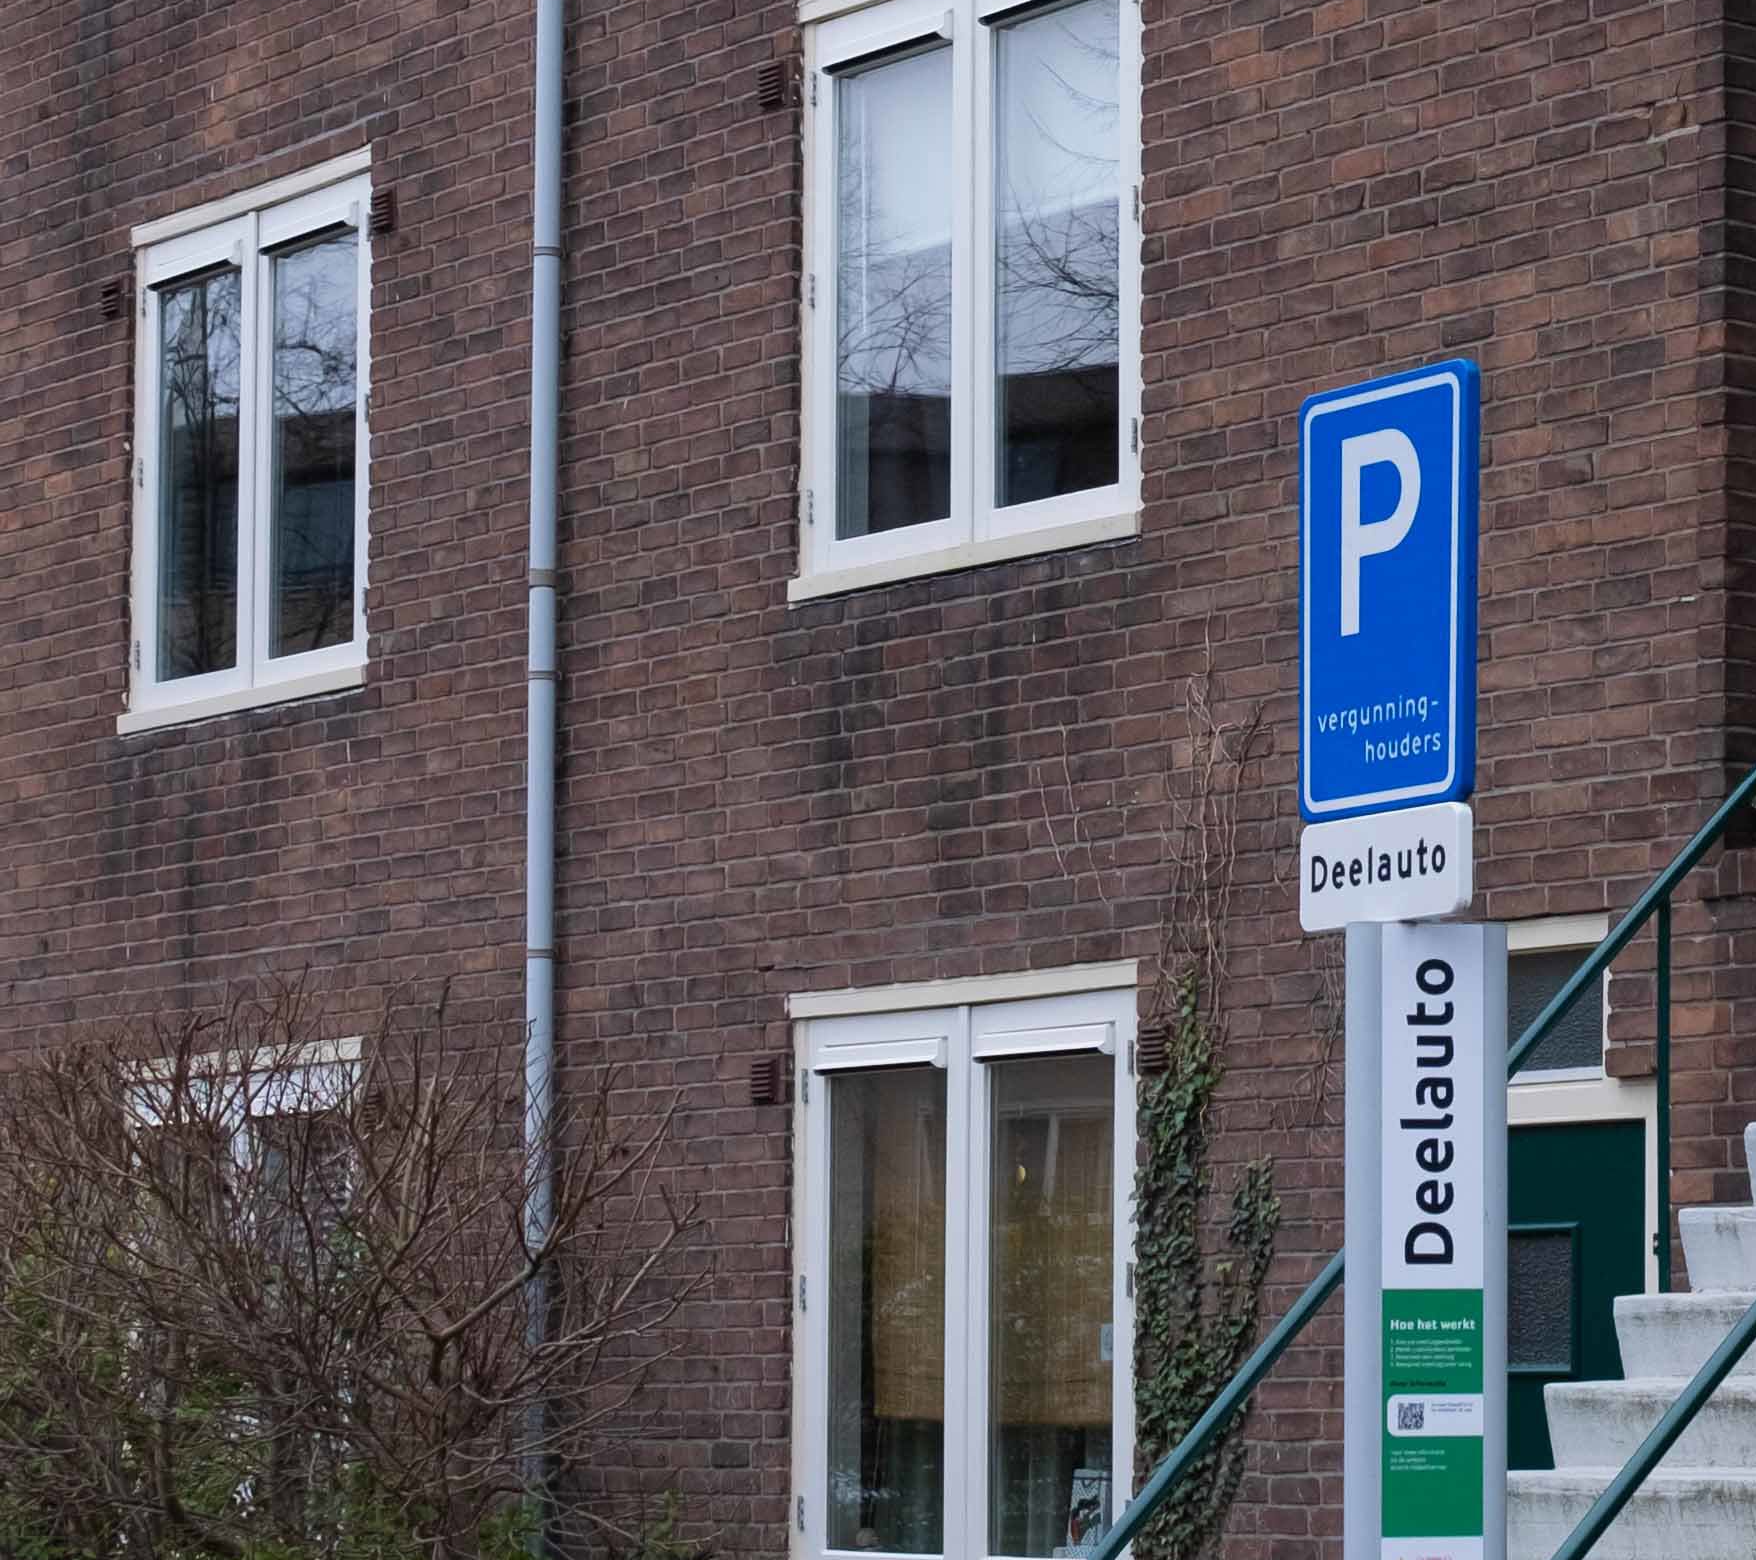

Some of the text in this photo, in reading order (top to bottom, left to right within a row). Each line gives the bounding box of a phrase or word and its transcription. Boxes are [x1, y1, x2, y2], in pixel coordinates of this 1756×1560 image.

[1341, 428, 1421, 637] P
[1317, 695, 1439, 735] vergunning-
[1365, 731, 1442, 764] houders
[1310, 837, 1446, 893] Deelauto
[1400, 958, 1455, 1265] Deelauto
[1390, 1318, 1476, 1330] Hoe het werkt
